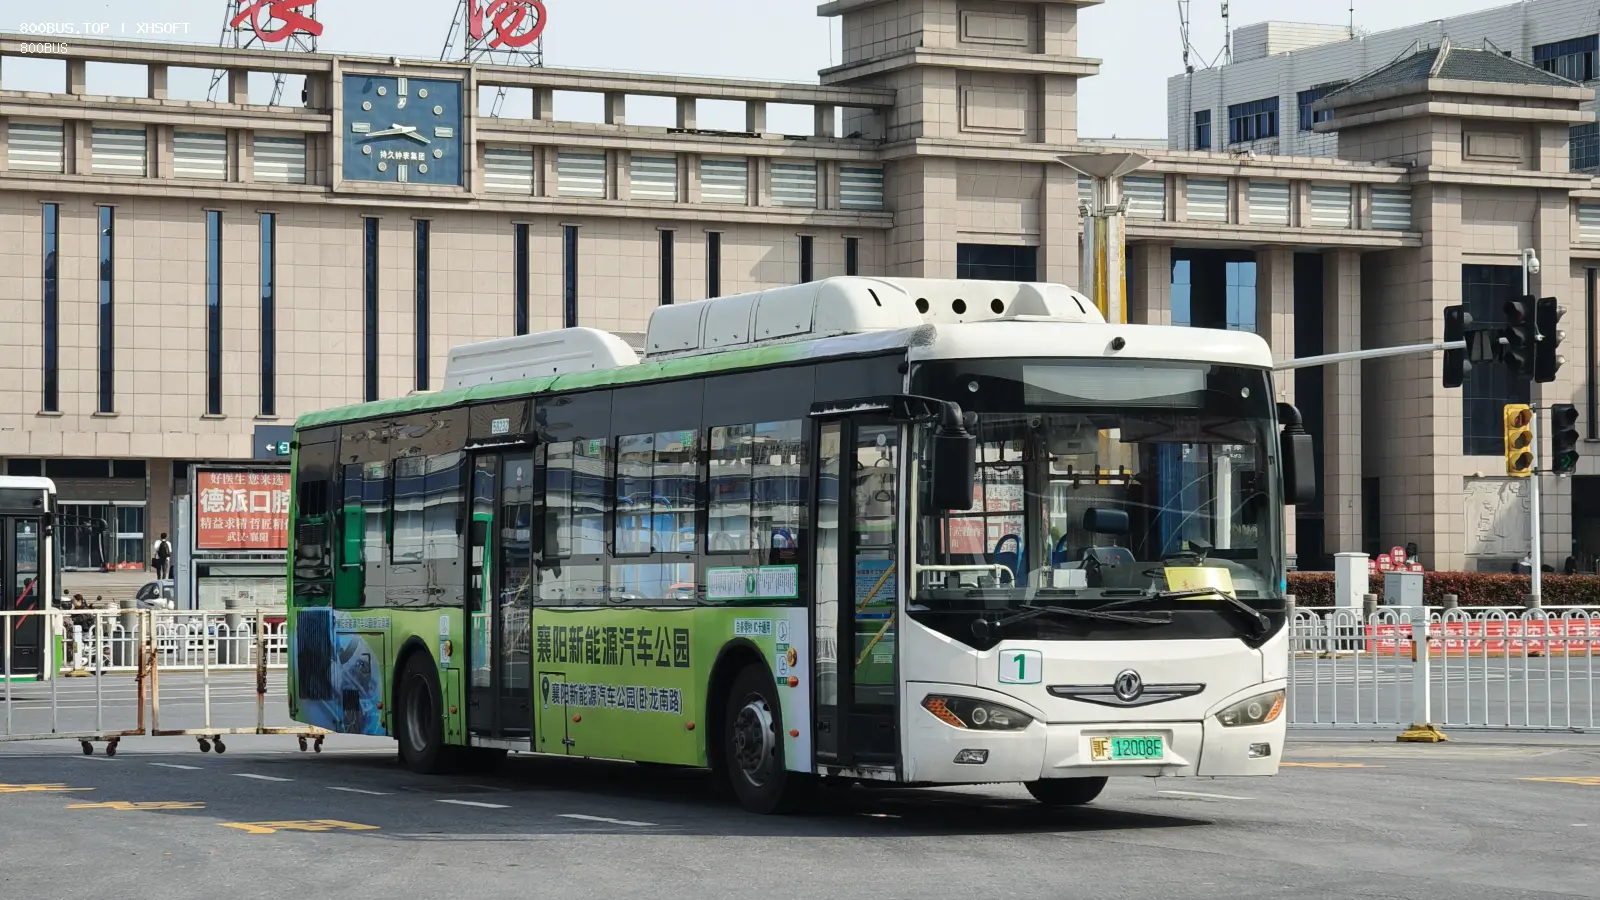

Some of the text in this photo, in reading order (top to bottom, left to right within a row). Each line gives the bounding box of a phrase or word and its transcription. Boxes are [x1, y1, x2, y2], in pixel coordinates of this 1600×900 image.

[380, 150, 425, 161] 持久钟表集团
[210, 472, 284, 486] 好医生 您来选
[200, 488, 290, 514] 德派口腔
[201, 517, 248, 530] 精益求精
[537, 625, 690, 668] 襄阳新能源汽车公园
[1013, 653, 1026, 680] 1
[552, 683, 683, 716] 襄阳新能源汽车公园(卧龙南路)
[1116, 739, 1162, 757] 12008F
